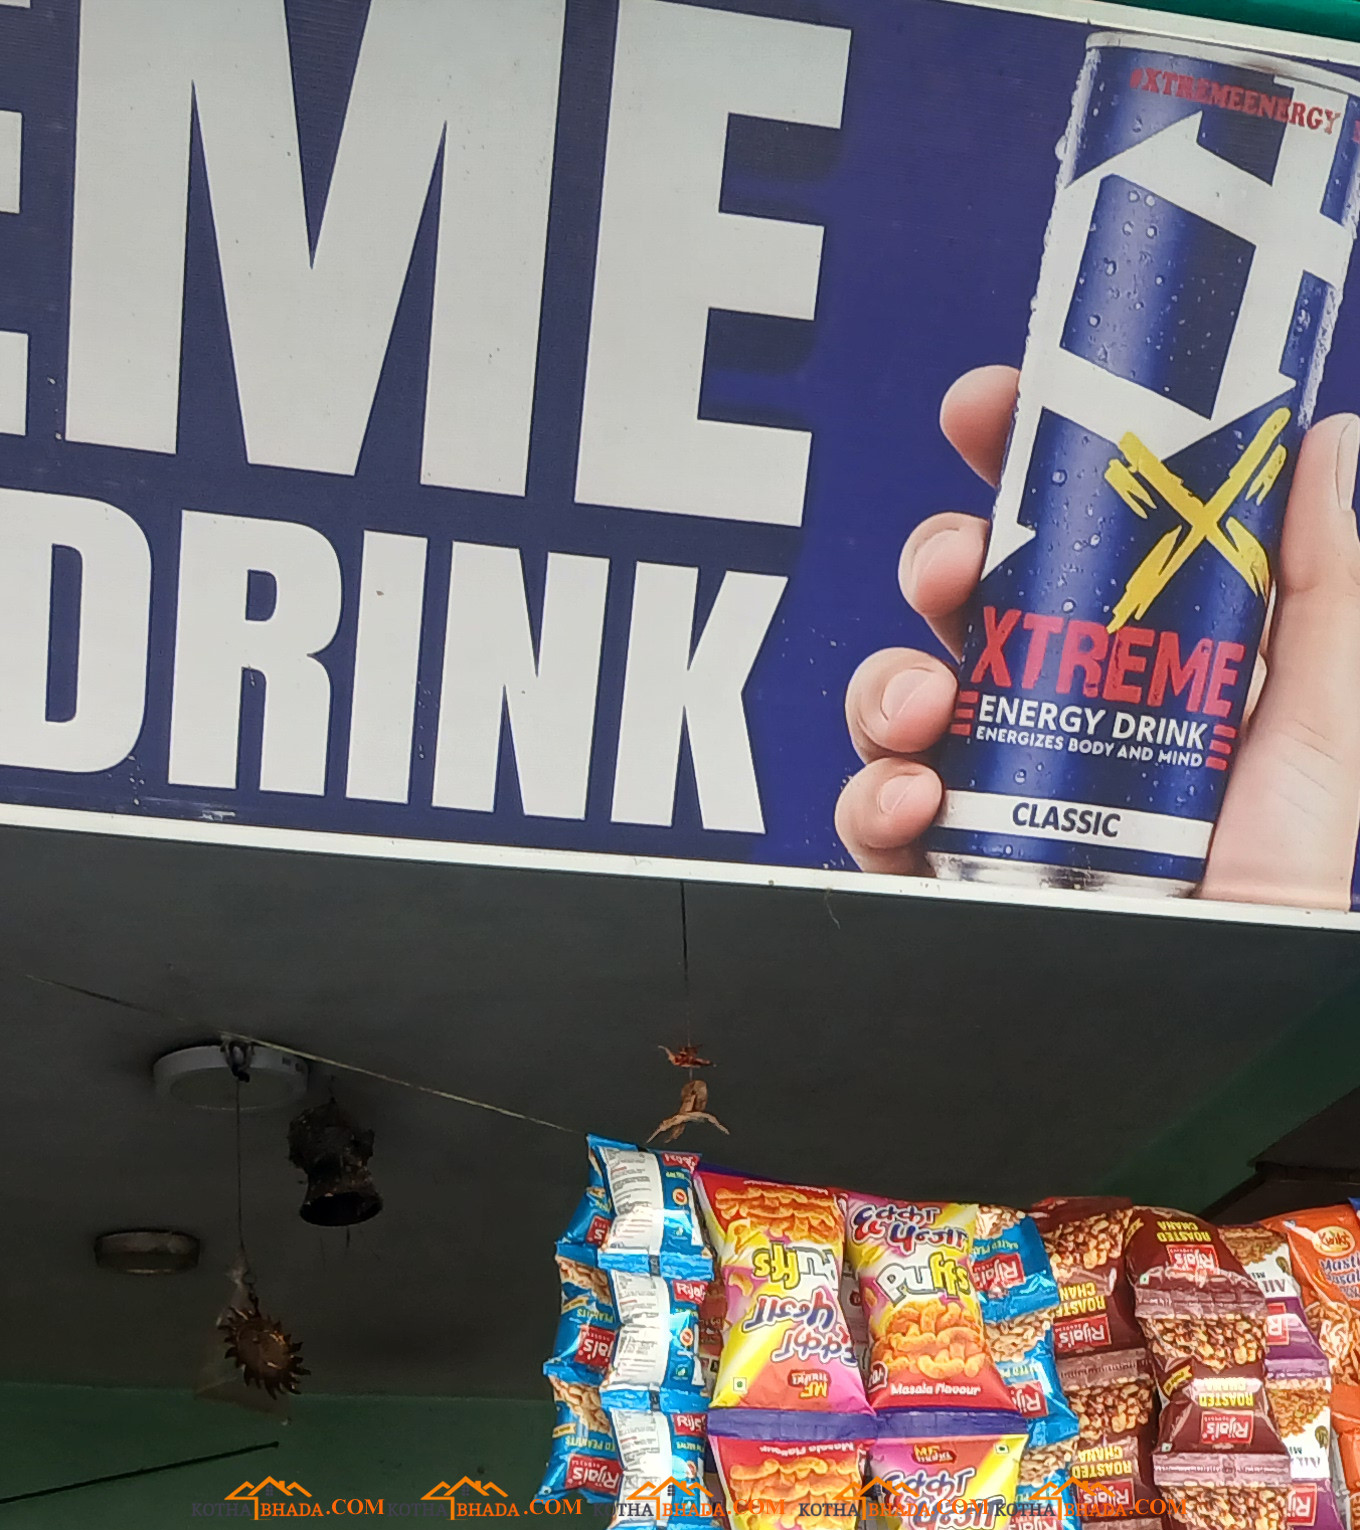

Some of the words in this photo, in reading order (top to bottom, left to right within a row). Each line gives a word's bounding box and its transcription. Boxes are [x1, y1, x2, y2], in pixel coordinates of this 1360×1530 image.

[971, 606, 1247, 718] XTREME
[978, 695, 1106, 735] ENERGY
[1112, 712, 1208, 751] DRINK
[976, 725, 1064, 751] ENERGIZES
[1068, 737, 1114, 758] BODY
[1116, 744, 1153, 763] AND
[1158, 751, 1203, 768] MIND
[1012, 802, 1121, 838] CLASSIC
[1056, 1295, 1107, 1318] ROASTE
[1059, 1282, 1097, 1301] CHAN
[891, 1382, 933, 1397] Masala
